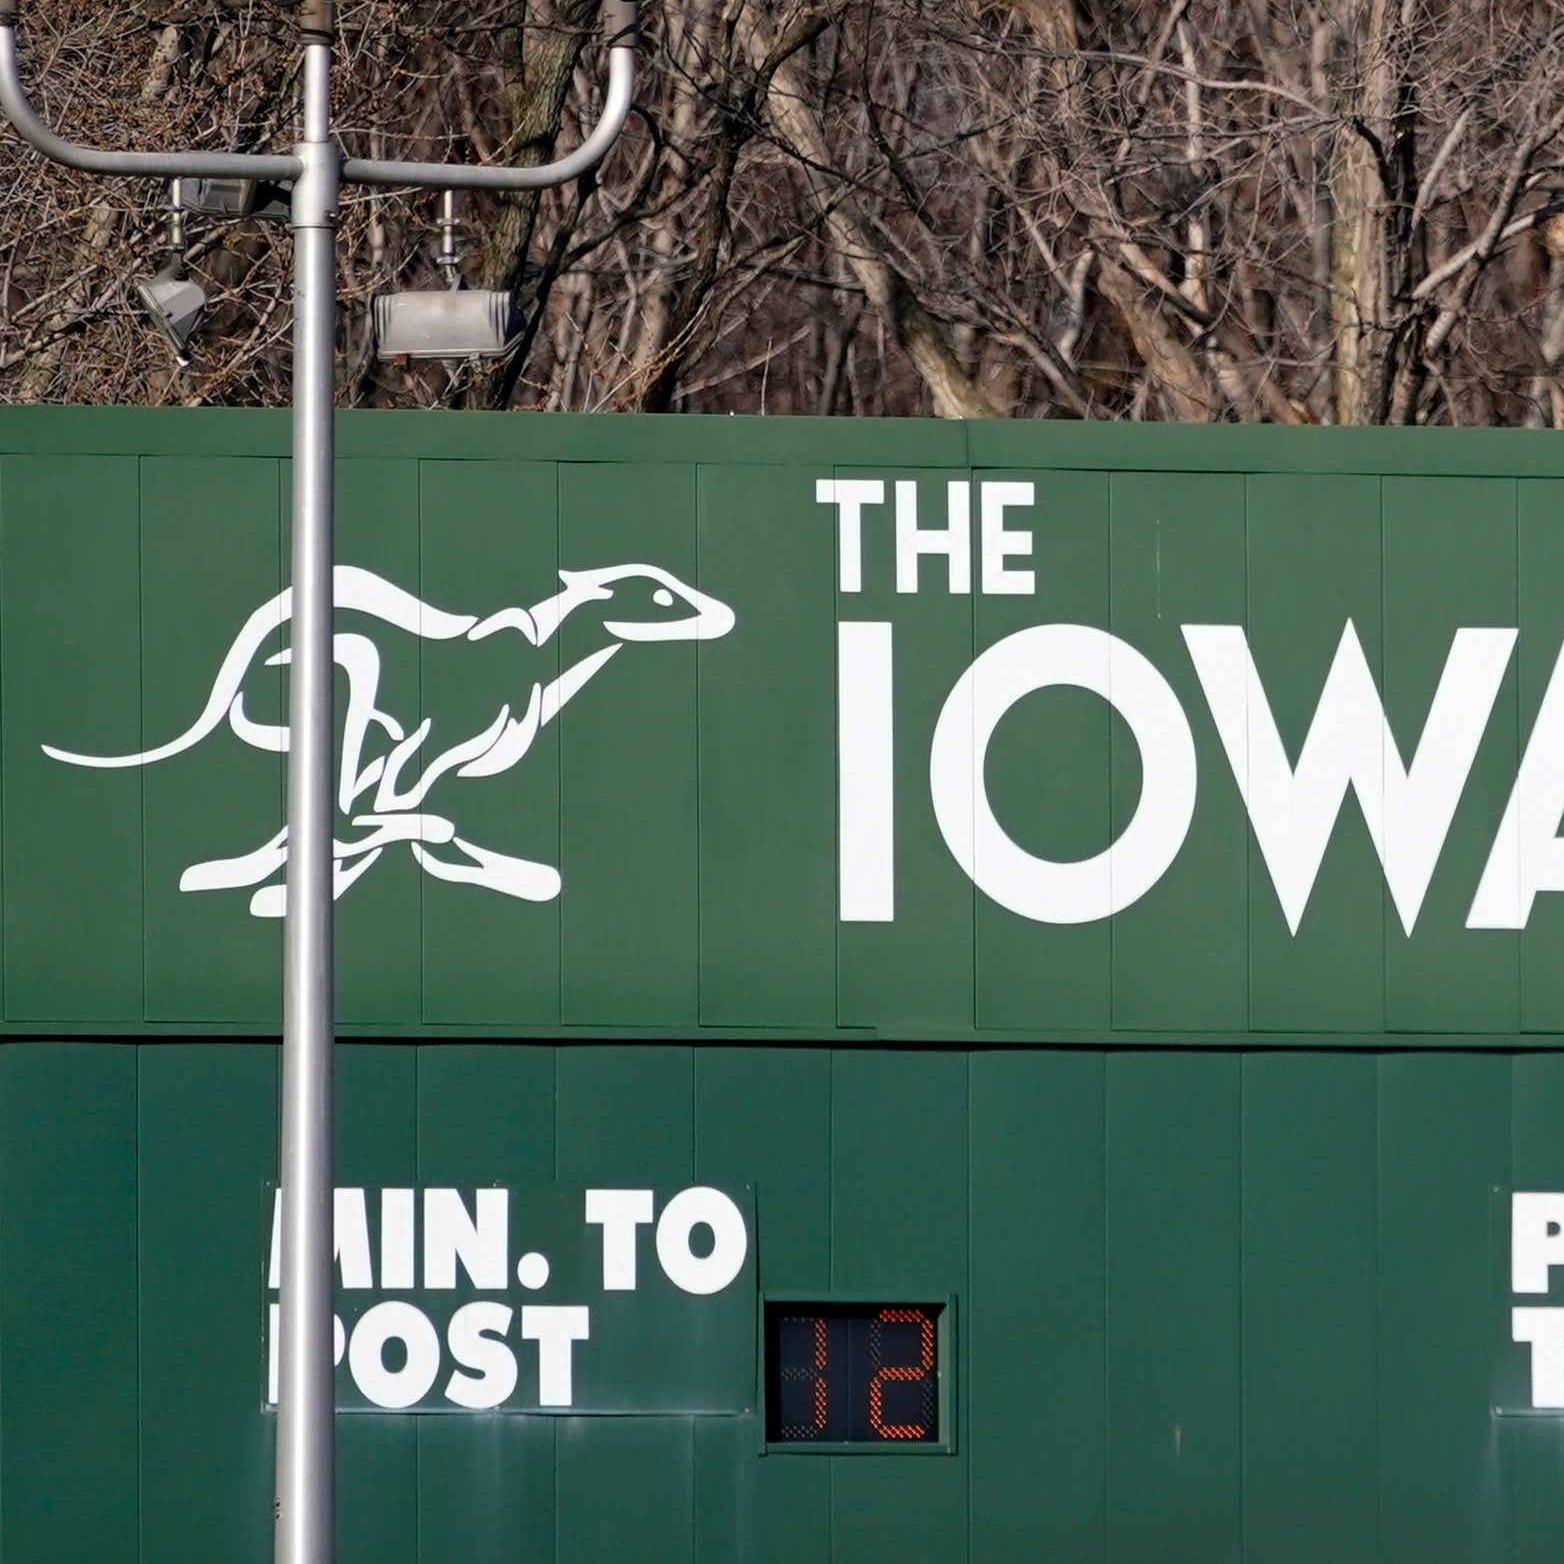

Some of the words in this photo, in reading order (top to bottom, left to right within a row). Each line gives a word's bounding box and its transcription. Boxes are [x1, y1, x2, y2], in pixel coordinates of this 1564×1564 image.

[816, 479, 1036, 595] THE
[585, 1186, 748, 1295] TO
[269, 1301, 590, 1411] OST
[814, 1308, 935, 1439] 12
